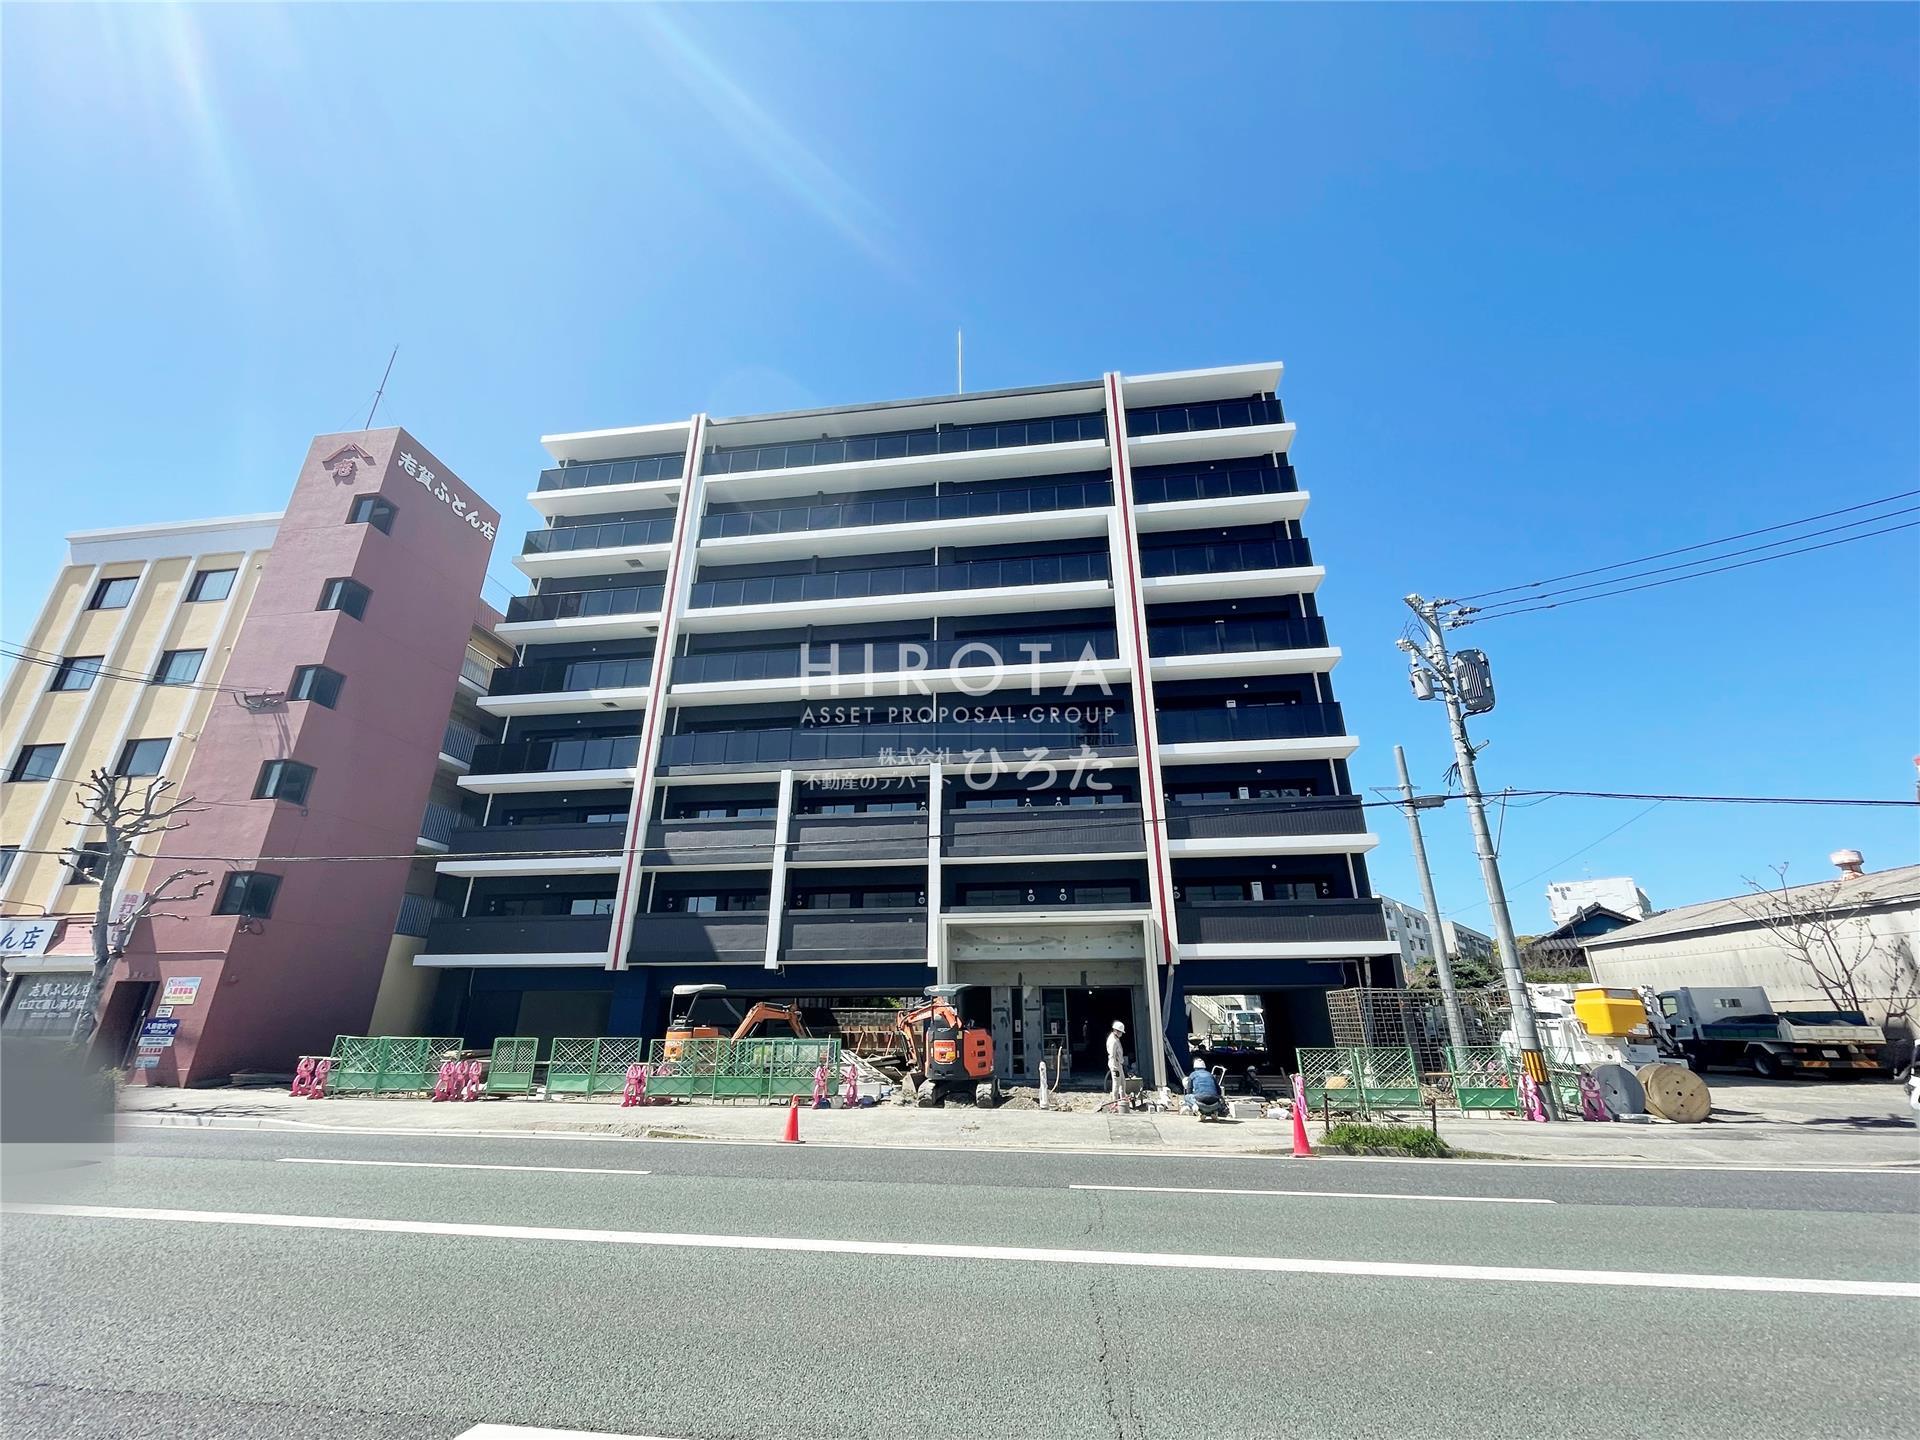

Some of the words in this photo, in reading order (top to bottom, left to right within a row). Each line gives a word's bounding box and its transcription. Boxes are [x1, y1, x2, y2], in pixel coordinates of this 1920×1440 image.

[398, 451, 495, 541] 志賀ふとん店
